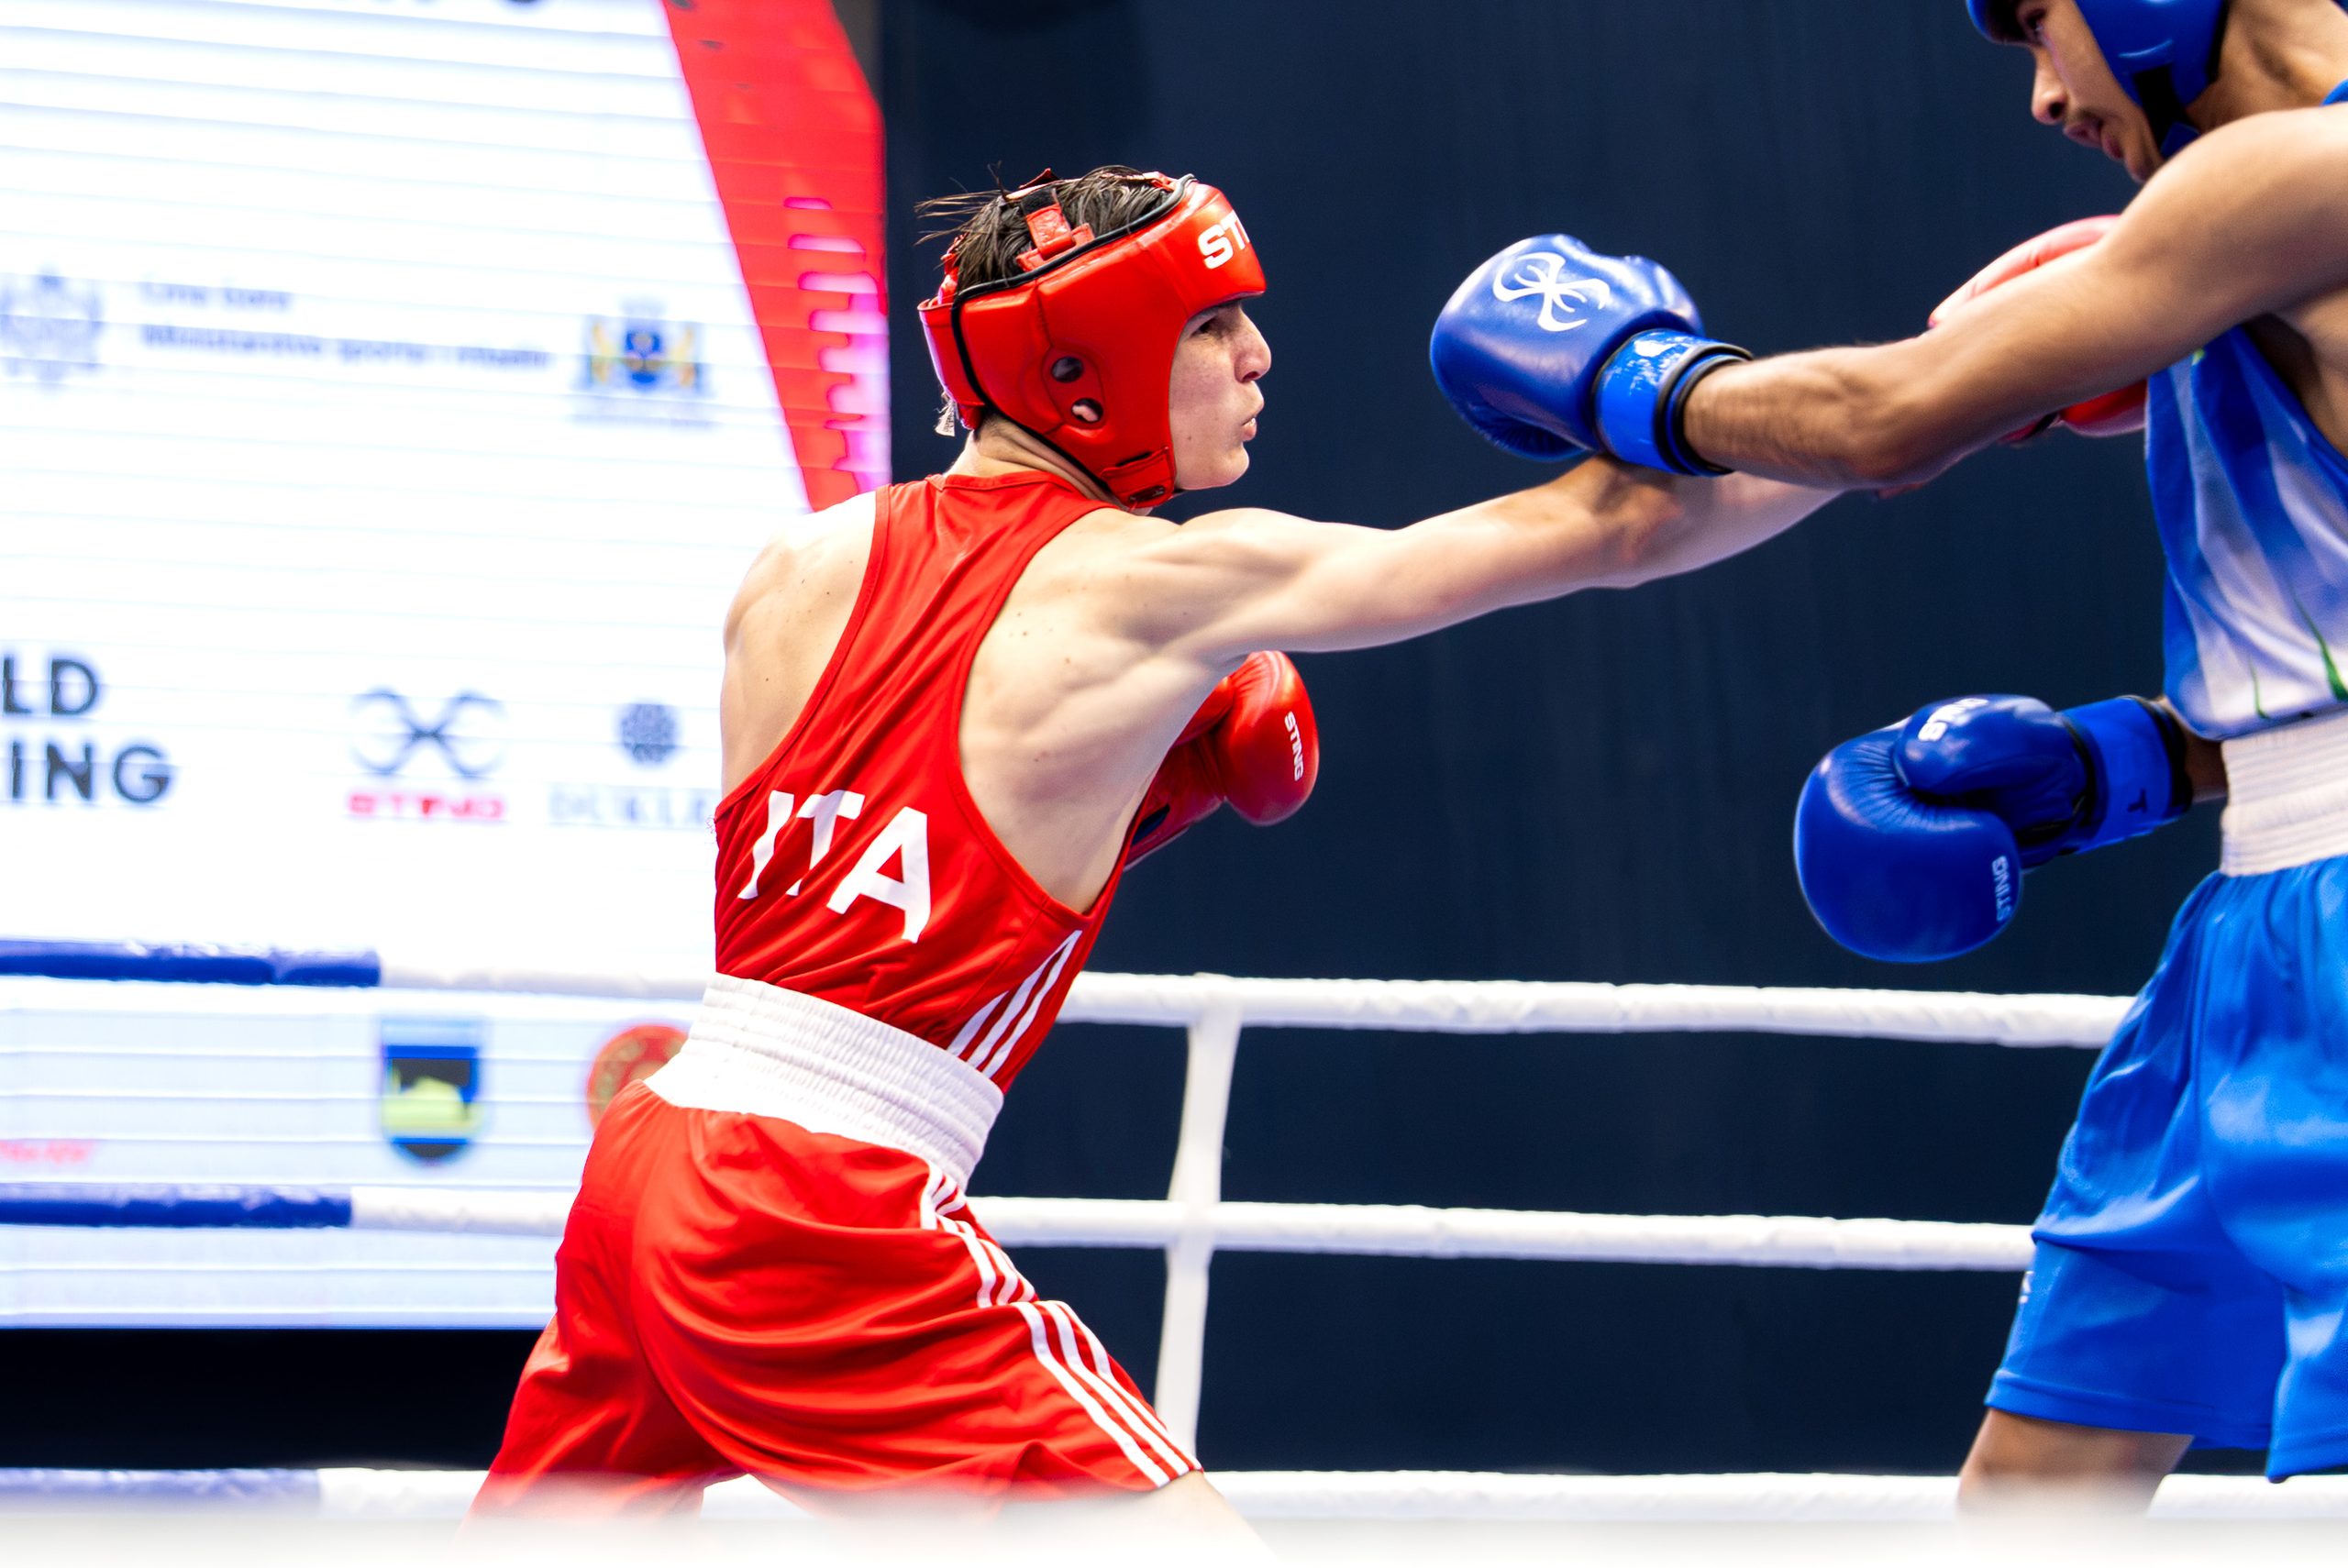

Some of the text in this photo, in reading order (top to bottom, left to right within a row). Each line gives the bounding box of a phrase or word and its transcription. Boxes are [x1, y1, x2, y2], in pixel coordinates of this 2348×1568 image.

[3, 657, 98, 715] LD
[12, 742, 172, 803] ING
[1284, 711, 1304, 781] STING
[737, 790, 931, 944] ITA
